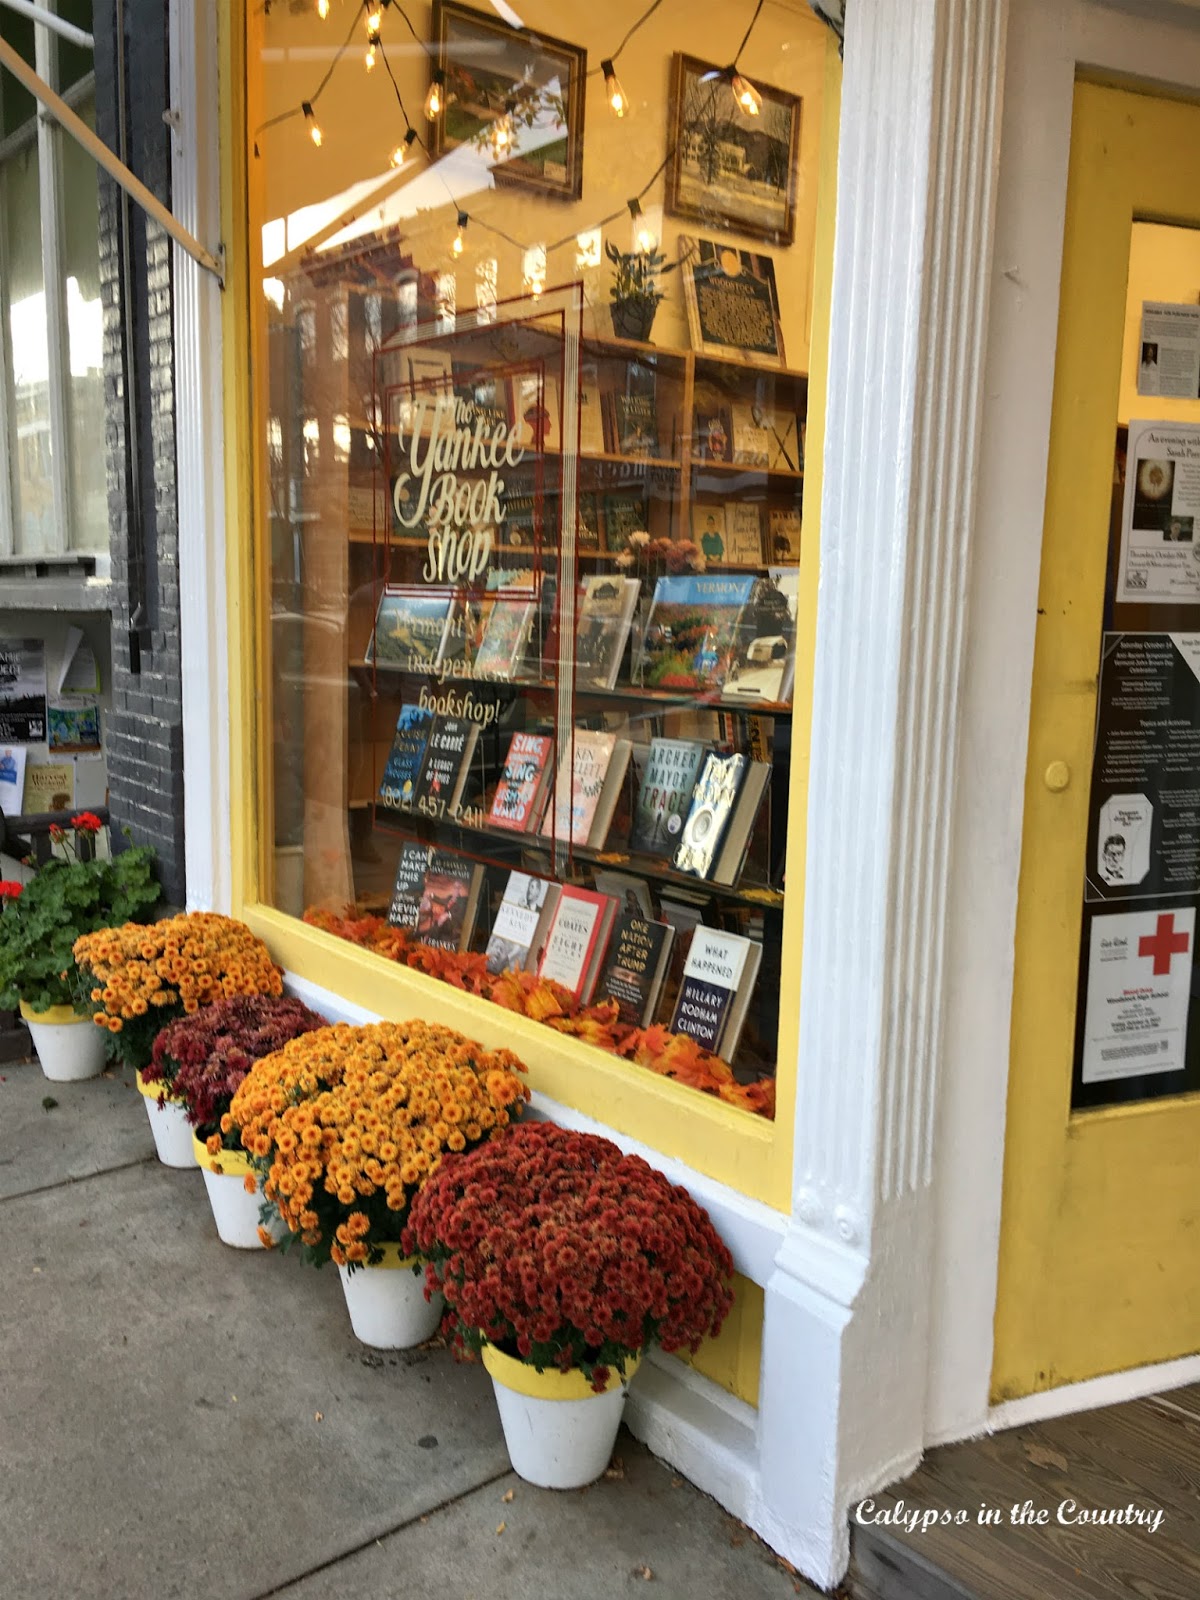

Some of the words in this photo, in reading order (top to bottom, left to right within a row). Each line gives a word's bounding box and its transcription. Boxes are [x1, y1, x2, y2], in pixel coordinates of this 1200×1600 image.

[394, 400, 525, 528] Yankee
[426, 471, 507, 527] Book
[695, 581, 747, 593] VERMONT
[418, 685, 500, 731] bookshop!
[649, 747, 697, 769] ARCHER
[505, 761, 536, 784] SING
[649, 768, 688, 790] MAYOR
[408, 849, 428, 861] CAN
[401, 859, 427, 872] MAKE
[400, 870, 420, 882] THIS
[396, 880, 409, 892] UP
[391, 902, 419, 916] KEVIN
[630, 918, 649, 933] ONE
[620, 930, 654, 949] NATION
[619, 943, 649, 961] AFTER
[705, 943, 729, 958] WHAT
[616, 954, 646, 973] TRUMP
[690, 958, 733, 980] HAPPENED
[685, 985, 723, 1009] HILLARY
[681, 1002, 718, 1025] RODHAM
[677, 1016, 714, 1041] CLINTON
